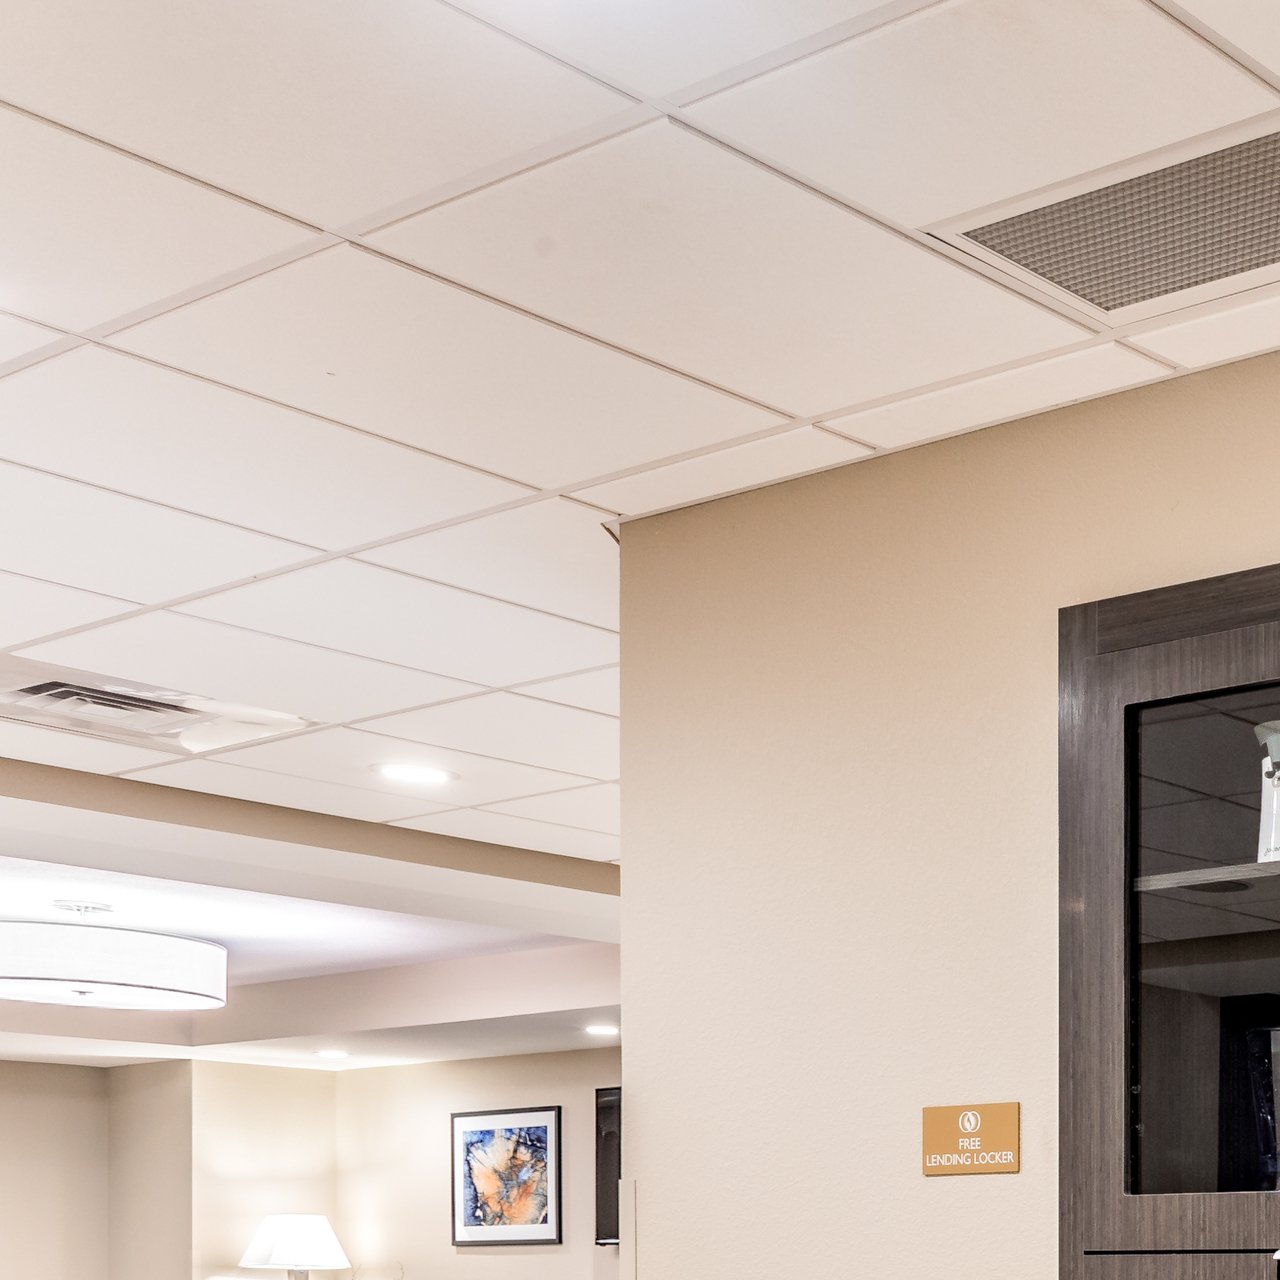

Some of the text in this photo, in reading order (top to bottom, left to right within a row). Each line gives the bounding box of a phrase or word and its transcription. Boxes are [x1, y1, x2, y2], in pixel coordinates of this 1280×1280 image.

[958, 1138, 981, 1150] FREE
[926, 1151, 1014, 1166] LENDING LOCKER
